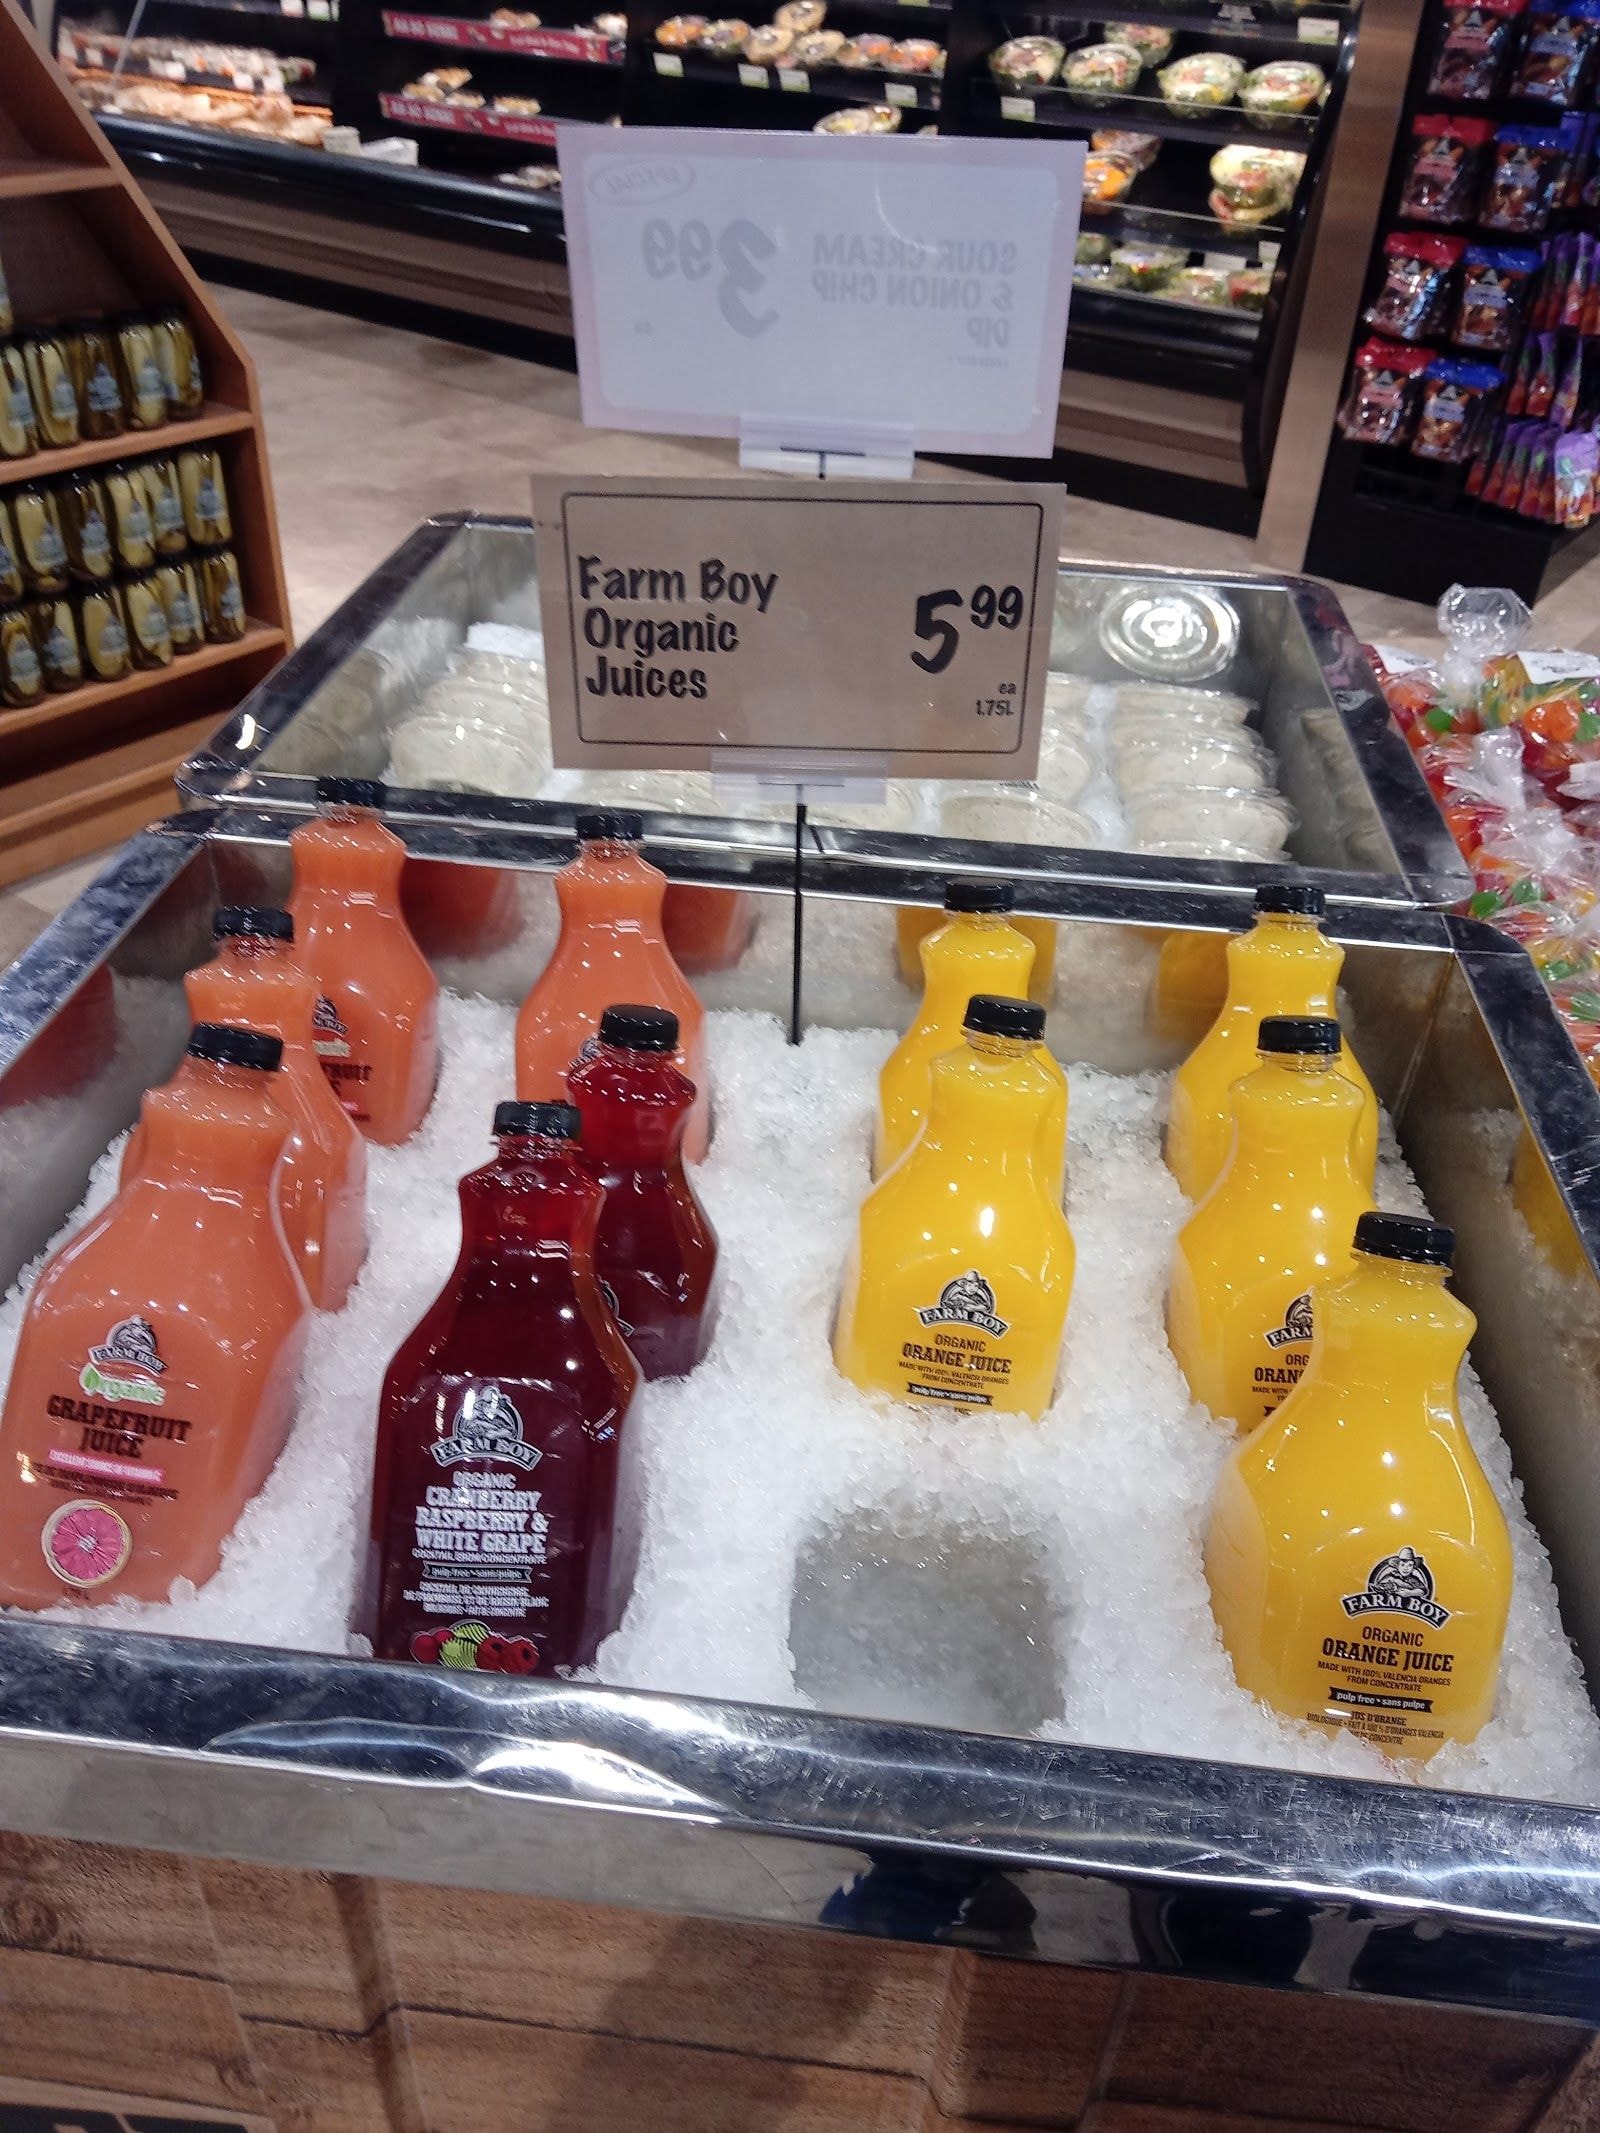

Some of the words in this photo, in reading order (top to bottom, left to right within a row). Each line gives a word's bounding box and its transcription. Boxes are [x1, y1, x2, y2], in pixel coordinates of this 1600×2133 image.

[577, 554, 686, 602] Farm
[698, 558, 779, 613] Boy
[583, 607, 740, 659] Organic
[910, 589, 964, 675] 5
[585, 656, 709, 700] Juices
[998, 682, 1017, 695] ea
[975, 699, 1015, 717] 1.75L
[921, 1308, 970, 1324] FARM
[973, 1313, 1006, 1333] BOY
[934, 1333, 986, 1353] ORGANIC
[902, 1342, 966, 1369] ORANGE
[969, 1354, 1013, 1375] JUICE
[1254, 1366, 1304, 1384] ORAN
[47, 1394, 192, 1441] GRAPEFRUIT
[79, 1426, 145, 1459] JUICE
[437, 1438, 489, 1460] FARM
[495, 1440, 535, 1462] BOY
[453, 1471, 517, 1490] ORGANIC
[425, 1485, 543, 1512] CRANBERRY
[415, 1506, 529, 1533] RASPBERRY
[530, 1512, 550, 1533] &
[415, 1527, 480, 1552] WHITE
[481, 1530, 547, 1555] GRAPE
[1347, 1594, 1402, 1613] FARM
[1408, 1597, 1447, 1624] BOY
[1362, 1625, 1424, 1647] ORGANIC
[1322, 1637, 1400, 1667] ORANGE
[1402, 1650, 1455, 1673] JUICE
[1317, 1660, 1340, 1672] MADE
[1341, 1664, 1361, 1676] WITH
[1383, 1671, 1418, 1684] VALENCIA
[1418, 1675, 1452, 1687] ORANGES
[1346, 1675, 1369, 1687] FROM
[1369, 1678, 1422, 1693] CONCENTRATE
[1336, 1691, 1356, 1703] pulp
[1357, 1694, 1376, 1705] free
[1381, 1698, 1402, 1707] sans
[1402, 1700, 1426, 1710] pulpe
[1351, 1710, 1365, 1721] JUS
[1367, 1712, 1407, 1727] D'ORANGE
